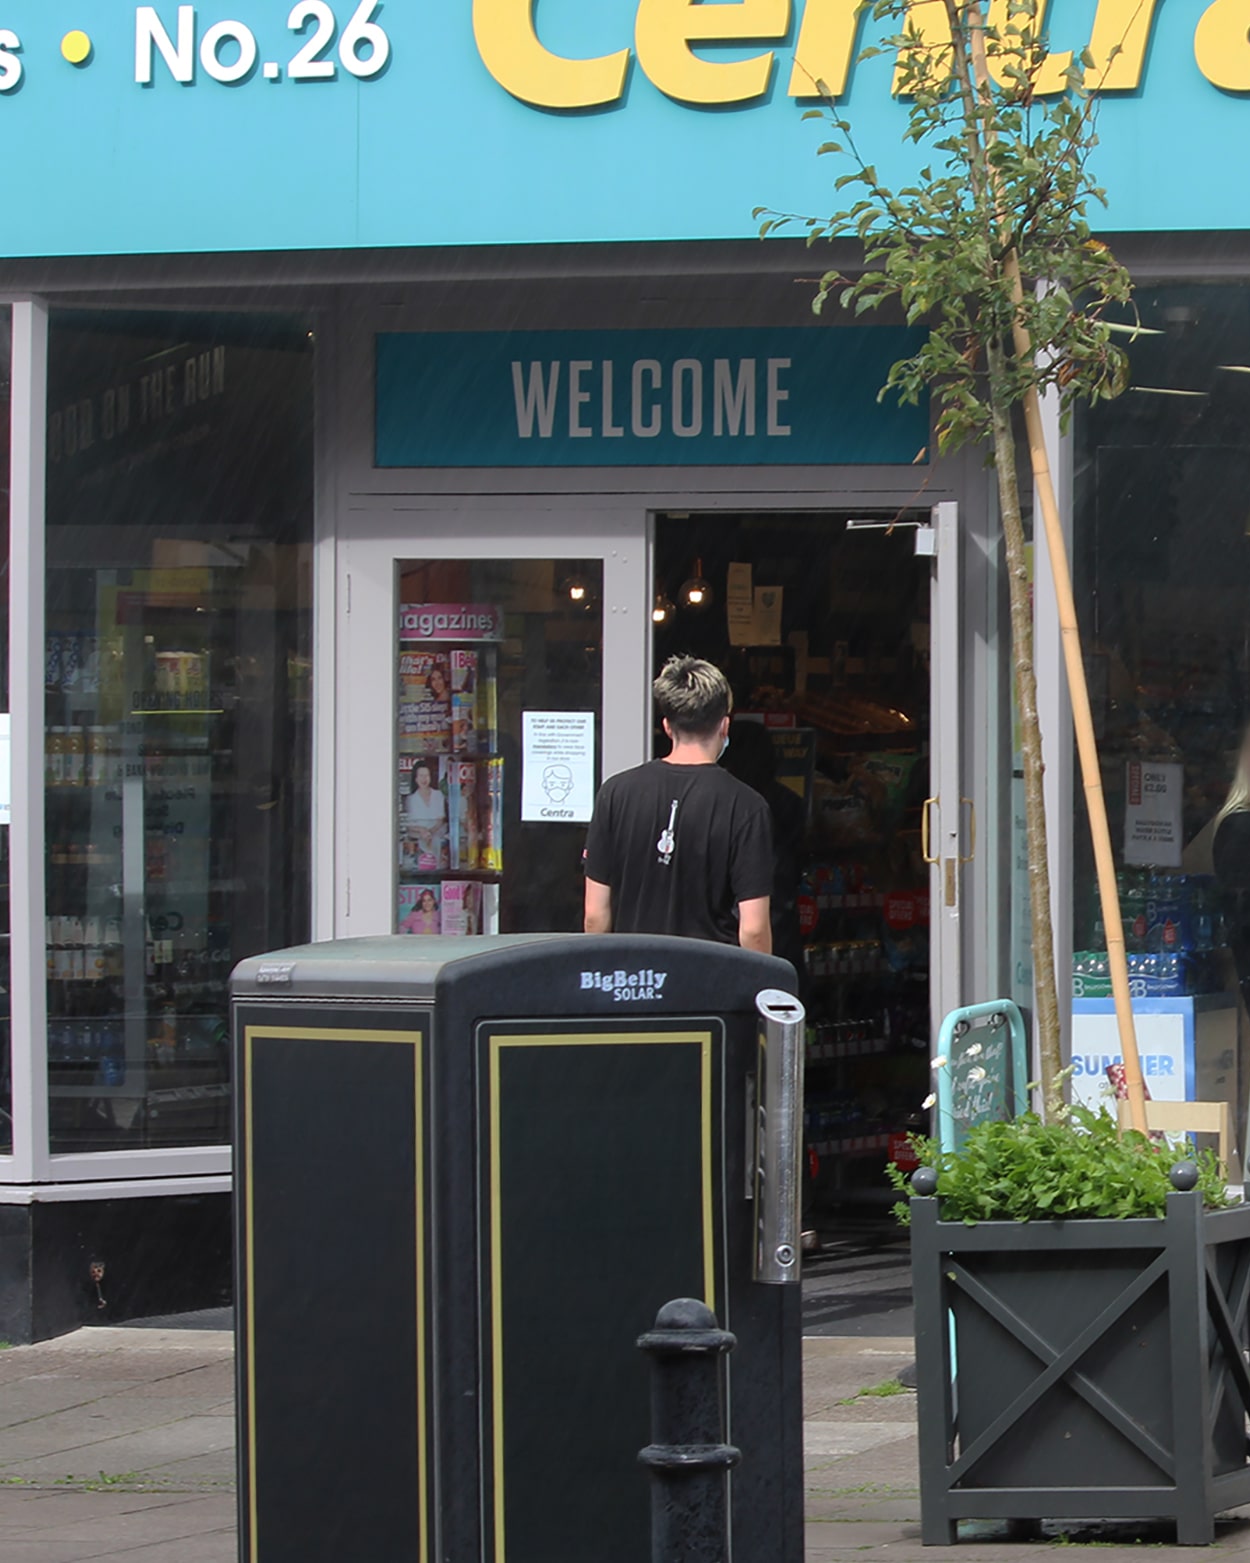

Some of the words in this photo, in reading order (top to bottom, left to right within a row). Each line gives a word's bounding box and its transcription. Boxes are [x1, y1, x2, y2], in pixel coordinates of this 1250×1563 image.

[135, 0, 390, 83] No.26
[511, 357, 792, 438] WELCOME
[400, 607, 494, 637] agazines
[540, 808, 576, 818] Centra
[580, 968, 668, 992] BigBelly
[614, 987, 655, 1002] SOLAR
[1071, 1055, 1174, 1076] SUMER
